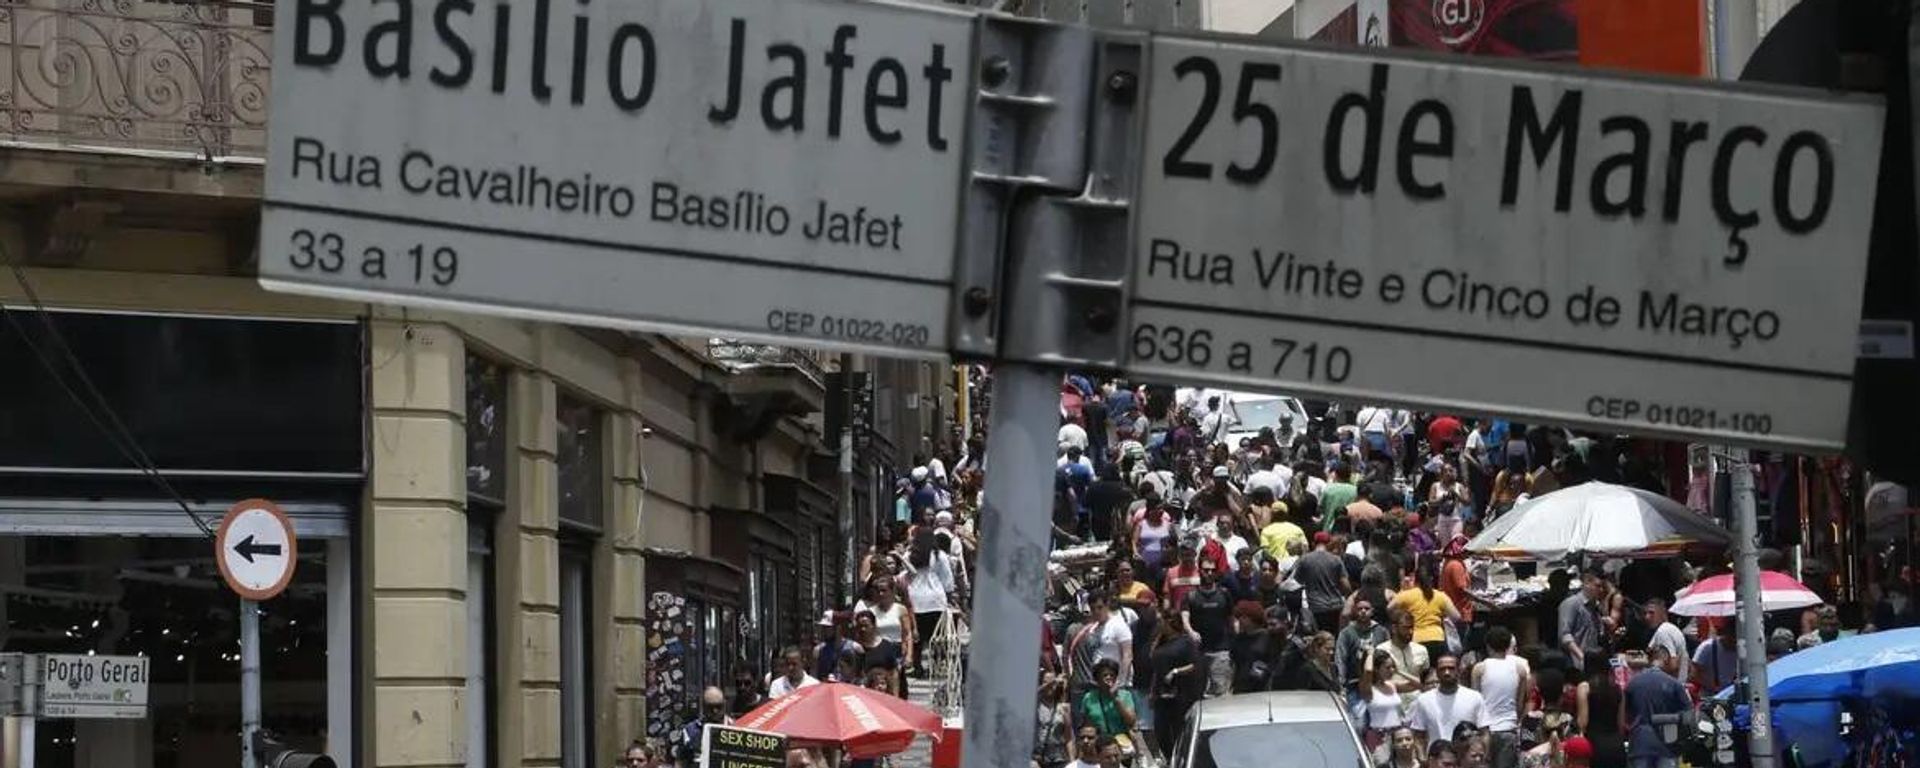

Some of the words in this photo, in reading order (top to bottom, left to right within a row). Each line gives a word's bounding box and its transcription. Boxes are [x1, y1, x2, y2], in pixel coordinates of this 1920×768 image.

[708, 18, 952, 151] Jafet
[1163, 56, 1281, 185] 25
[1324, 64, 1454, 199] de
[1500, 85, 1834, 267] Março
[292, 137, 381, 188] Rua
[400, 151, 634, 218] Cavalheiro
[651, 182, 790, 236] Basílio
[803, 200, 903, 250] Jafet
[290, 230, 344, 273] 33
[361, 246, 386, 279] a
[408, 243, 458, 286] 19
[1148, 239, 1233, 285] Rua
[1252, 248, 1363, 299] Vinte
[1379, 274, 1405, 302] e
[1422, 269, 1549, 321] Cinco
[1566, 285, 1621, 328] de
[1638, 290, 1780, 348] Março
[767, 310, 815, 334] CEP
[821, 316, 929, 346] 01022-020
[1133, 324, 1213, 367] 636
[1227, 342, 1252, 372] a
[1271, 338, 1352, 383] 710
[1587, 396, 1640, 420] CEP
[1643, 404, 1772, 434] 01021-100
[48, 658, 93, 683] Porto
[101, 660, 146, 684] Geral
[720, 730, 743, 746] SEX
[746, 734, 778, 750] SHOP
